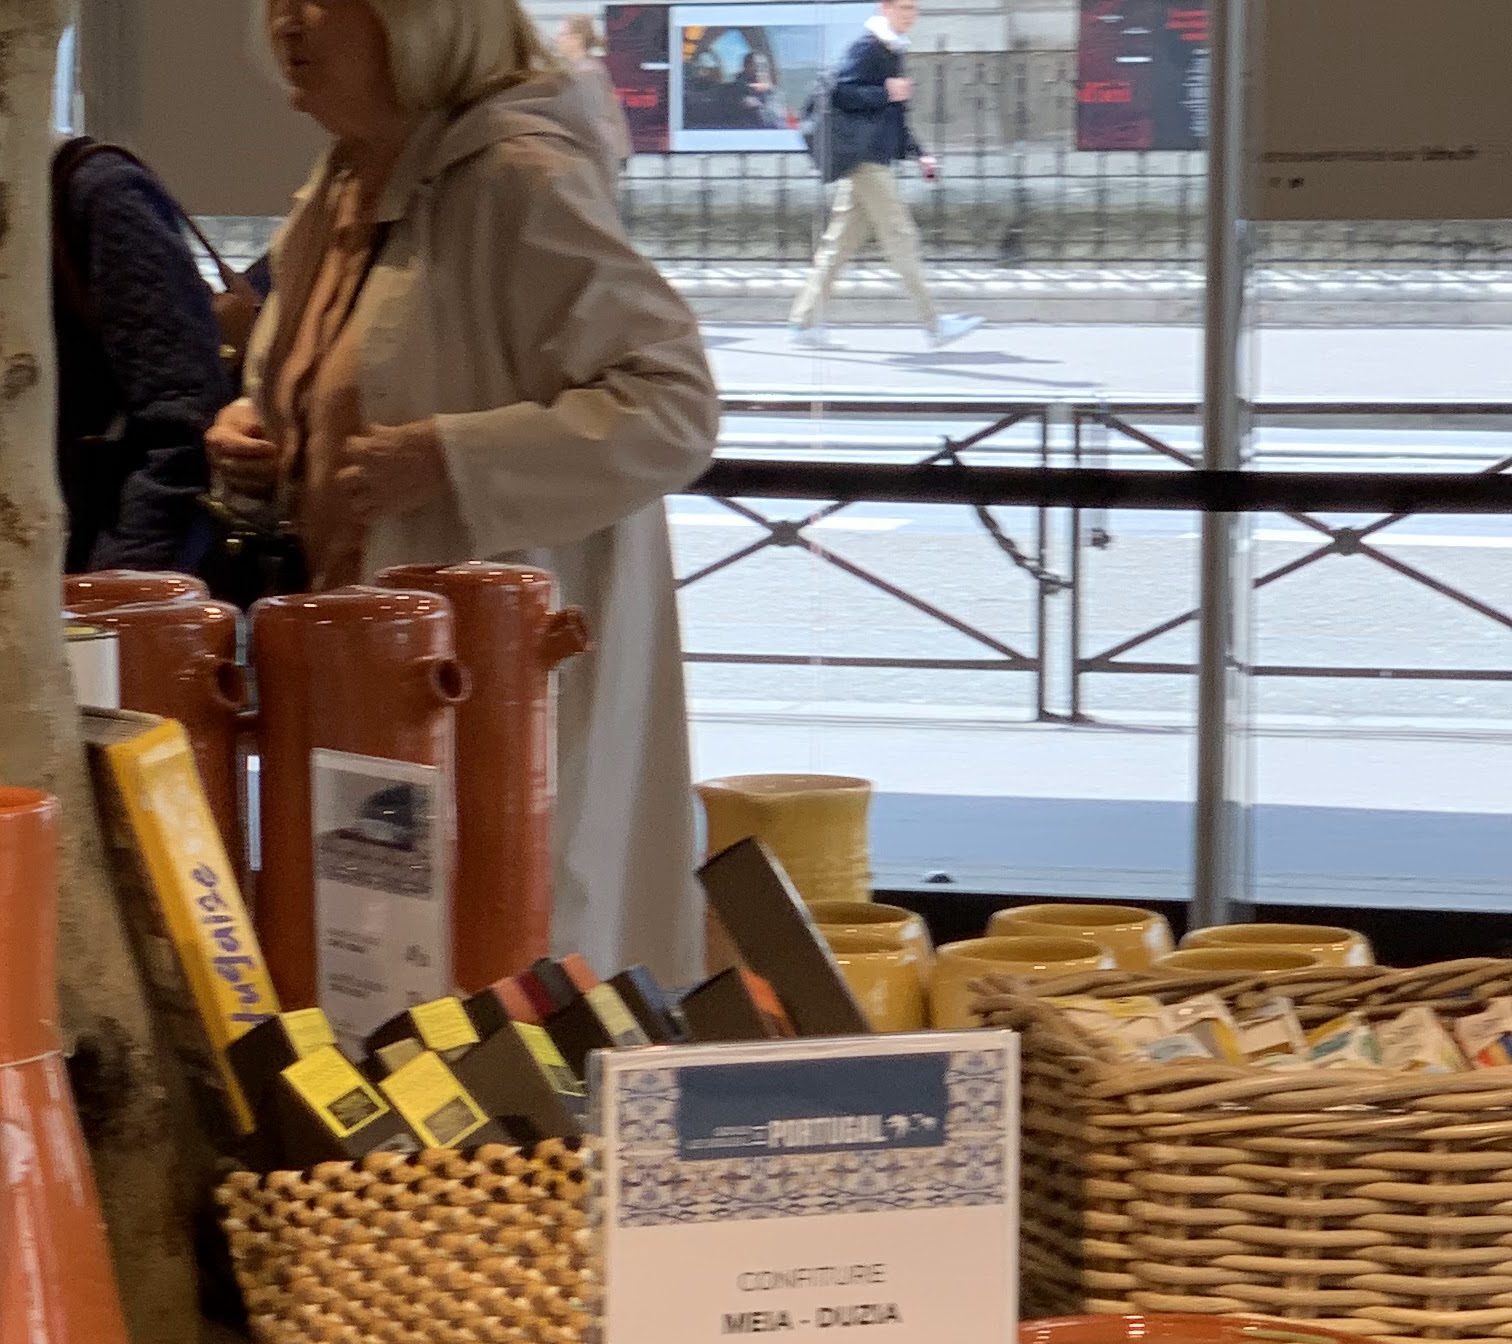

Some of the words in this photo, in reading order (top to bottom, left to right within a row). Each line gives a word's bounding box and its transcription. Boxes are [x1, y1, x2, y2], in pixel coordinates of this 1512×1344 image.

[736, 1263, 887, 1292] CONFITURE
[721, 1310, 795, 1335] MEIA
[815, 1303, 904, 1329] DUZIA
